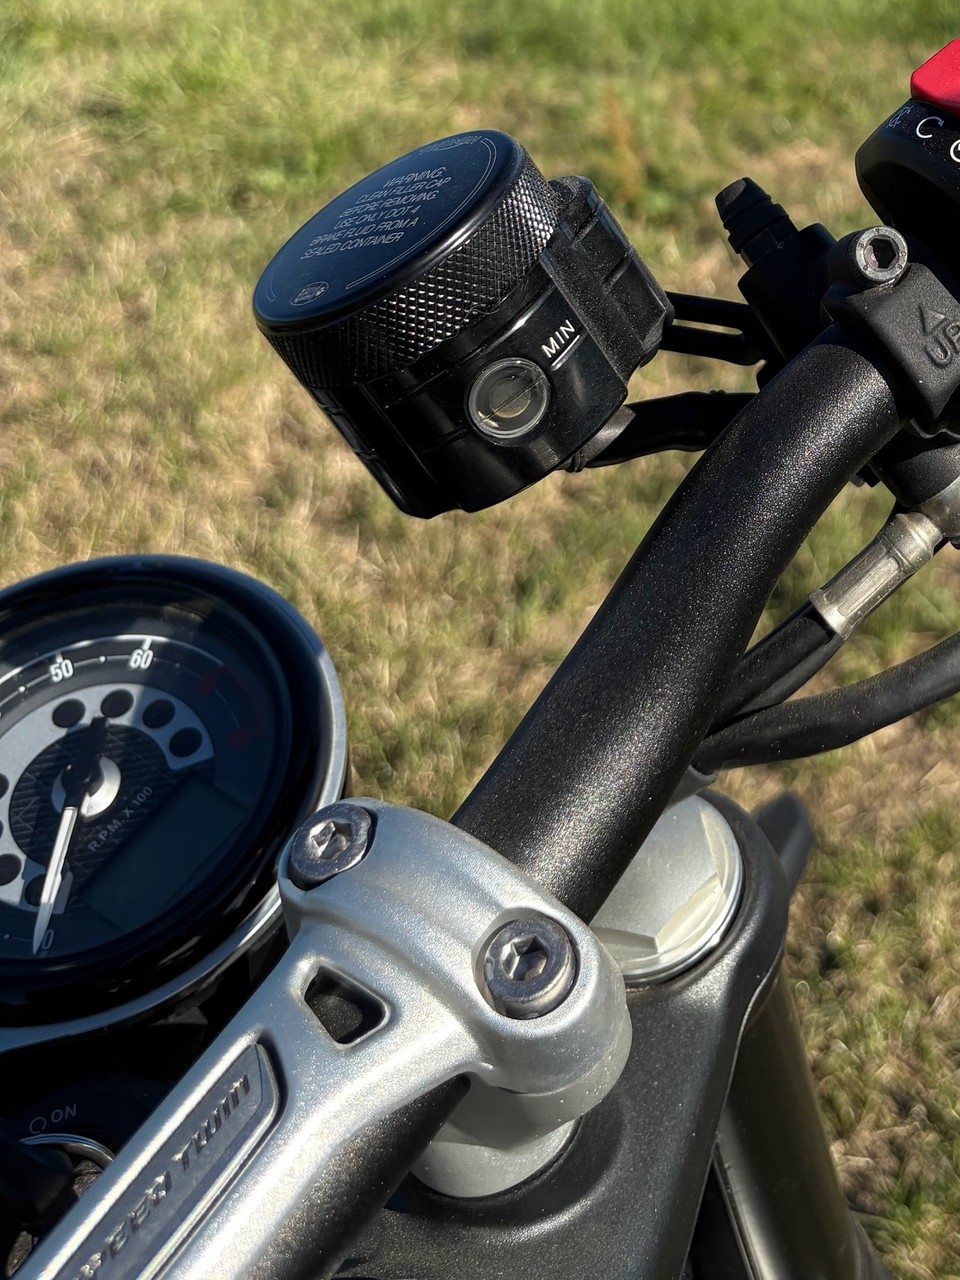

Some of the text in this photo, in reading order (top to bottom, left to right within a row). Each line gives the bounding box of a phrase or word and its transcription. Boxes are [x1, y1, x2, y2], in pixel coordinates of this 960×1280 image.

[356, 177, 451, 204] CLEAN FILLER CAP
[333, 204, 421, 229] USE ONLY DOT 4
[339, 200, 384, 217] BEFORE
[309, 217, 419, 247] BRAKE FLUID FROM A
[300, 231, 404, 259] SEALED CONTAINER
[541, 319, 575, 358] MIN
[50, 659, 74, 682] 50
[129, 649, 153, 669] 60
[132, 786, 152, 806] 100
[41, 928, 54, 949] 0
[50, 1103, 76, 1122] ON
[72, 1171, 172, 1280] PEED
